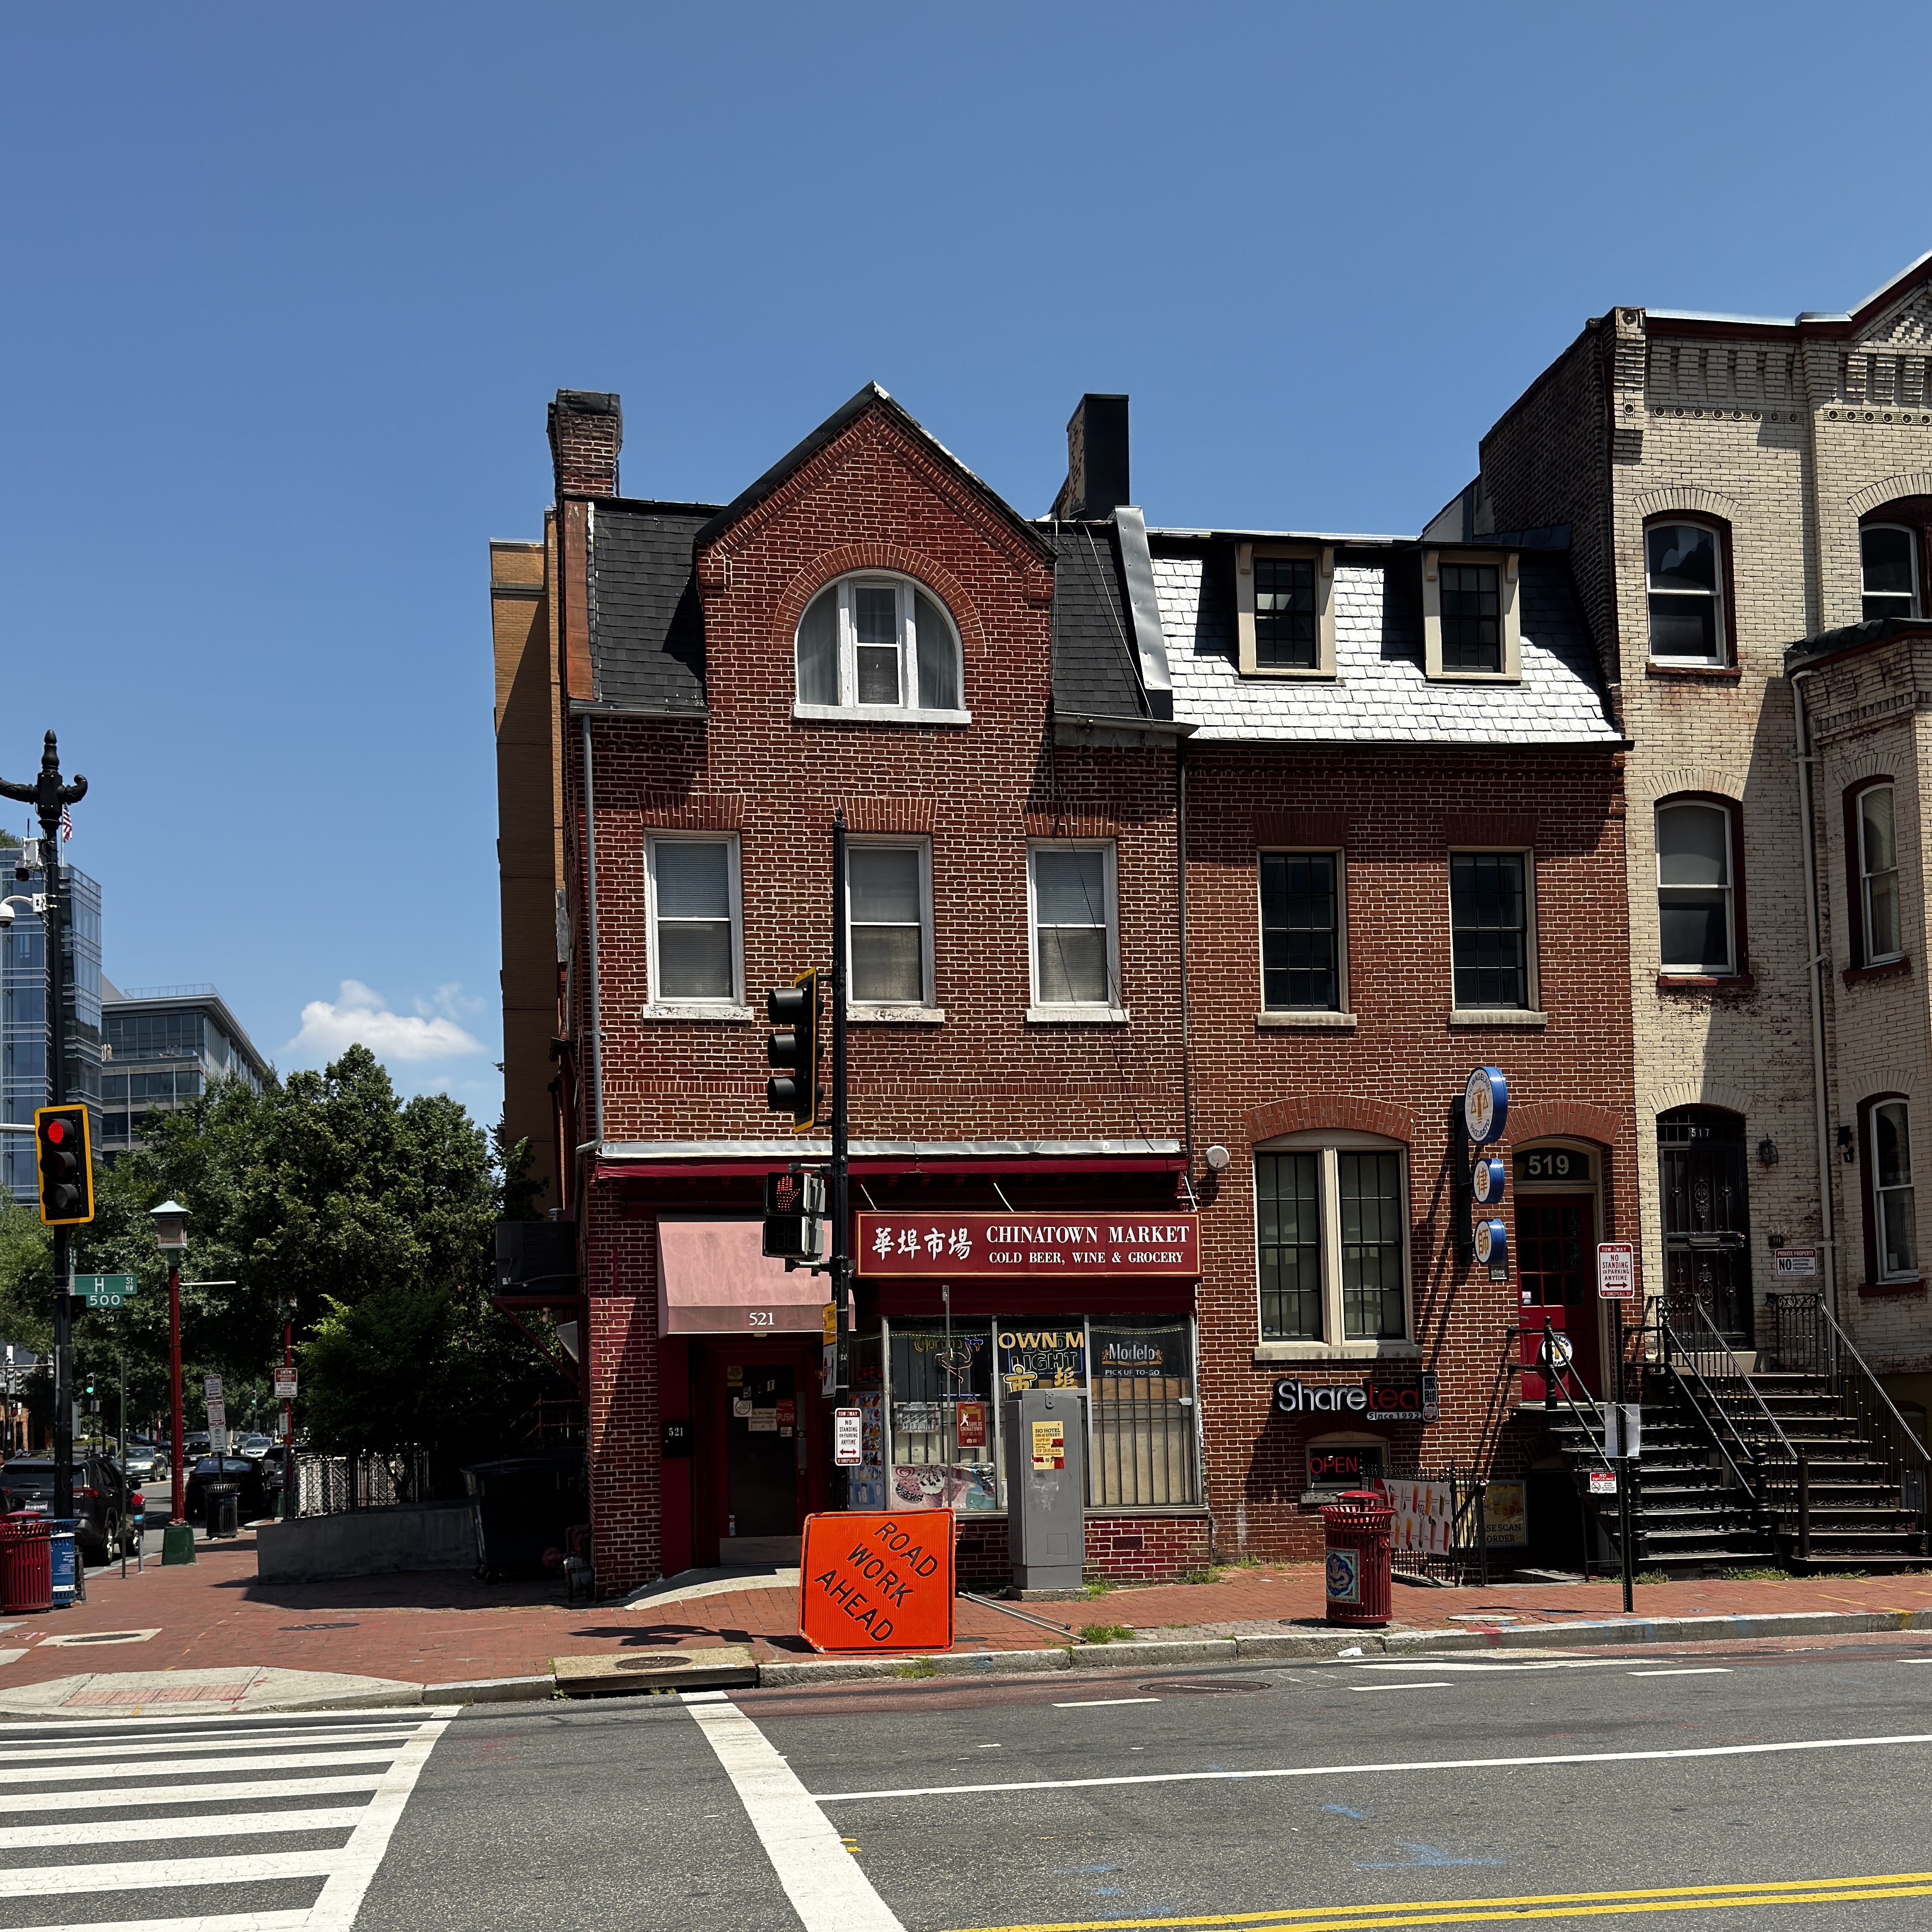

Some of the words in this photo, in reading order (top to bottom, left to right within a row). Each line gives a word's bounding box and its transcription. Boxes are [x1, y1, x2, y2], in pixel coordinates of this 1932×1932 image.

[1691, 1128, 1709, 1137] 517
[1529, 1155, 1569, 1175] 519
[986, 1226, 1098, 1243] CHINATOWN
[1108, 1226, 1189, 1243] MARKET
[872, 1227, 972, 1261] 華埠市場
[989, 1252, 1022, 1263] COLD
[1029, 1252, 1065, 1265] BEER,
[1072, 1252, 1105, 1263] WINE
[1111, 1252, 1121, 1263] &
[1128, 1252, 1184, 1263] GROCERY
[1779, 1259, 1792, 1270] NO
[95, 1278, 104, 1292] H
[90, 1295, 120, 1305] 500
[749, 1312, 775, 1326] 521
[1109, 1343, 1155, 1360] Modelo
[1279, 1379, 1419, 1411] Sharetea
[777, 1412, 795, 1421] PUSH
[669, 1427, 683, 1436] 521
[1310, 1456, 1357, 1474] OPEN
[1498, 1523, 1521, 1532] SCAN
[1486, 1535, 1515, 1543] ORDER
[873, 1521, 938, 1577] ROAD
[846, 1542, 915, 1608] WORK
[813, 1569, 894, 1641] AHEAD
